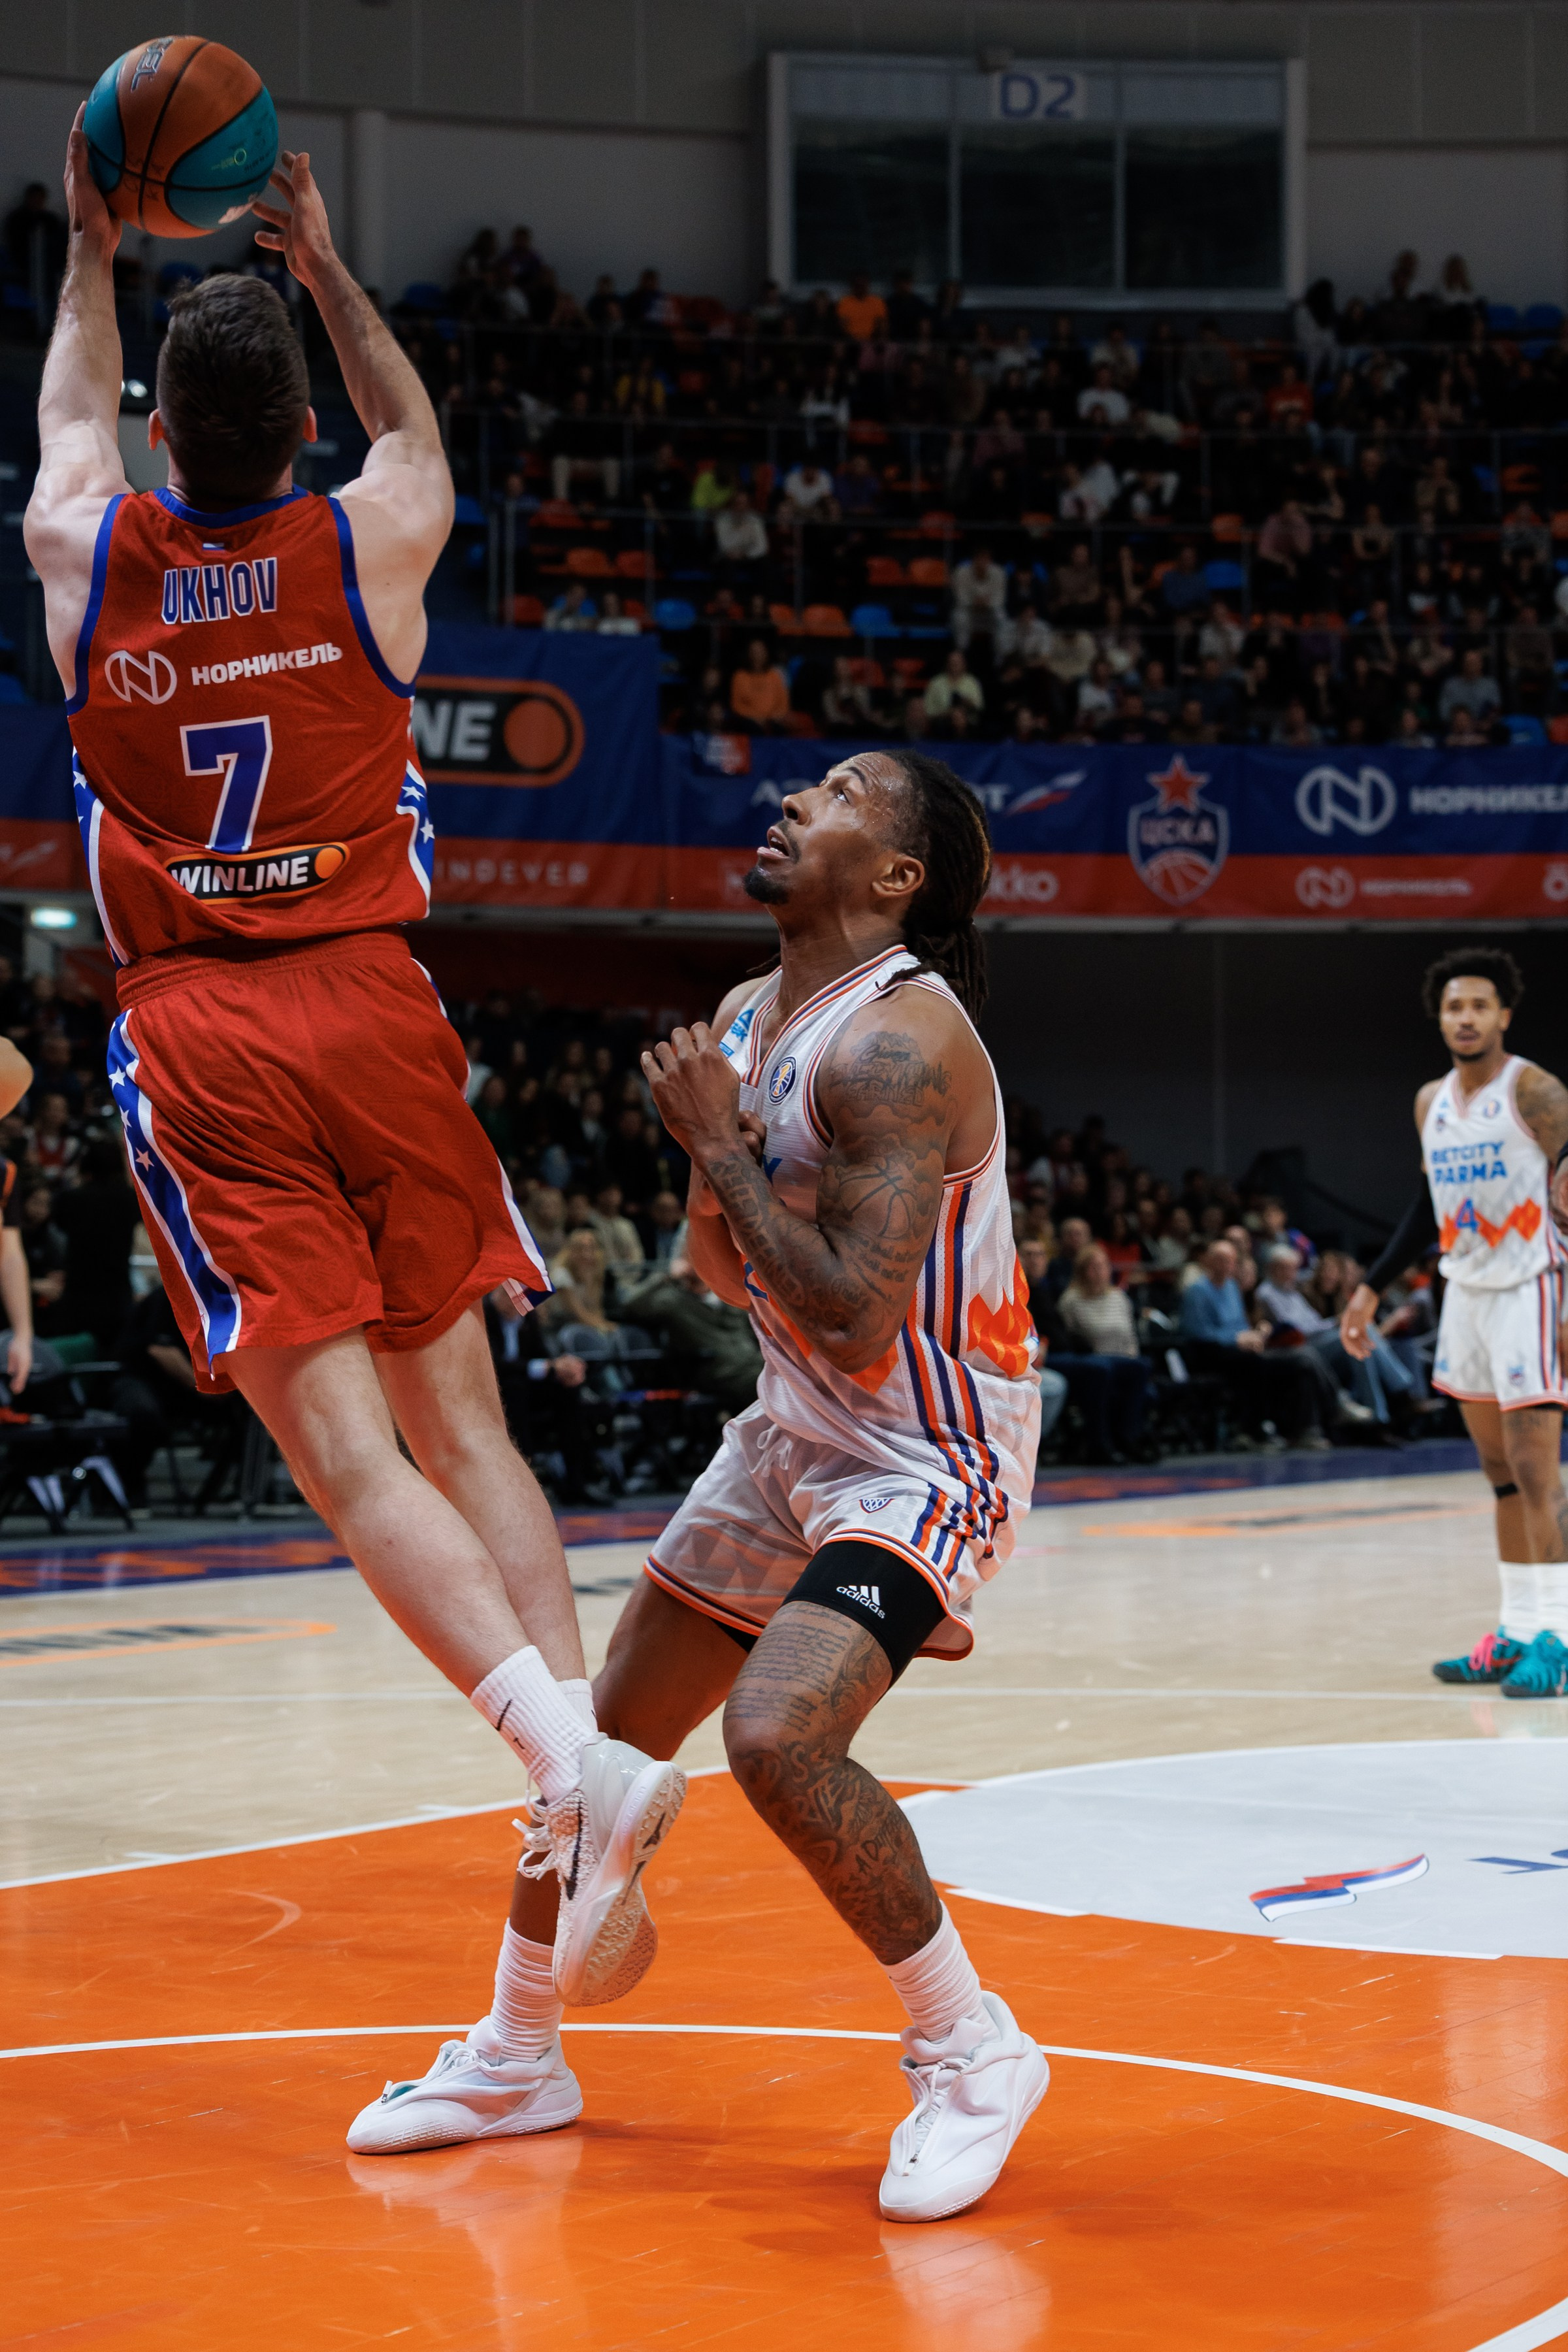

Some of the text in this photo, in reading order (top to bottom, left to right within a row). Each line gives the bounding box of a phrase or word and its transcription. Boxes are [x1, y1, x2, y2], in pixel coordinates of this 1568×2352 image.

[1000, 73, 1075, 118] D2
[161, 557, 277, 625] UKHOV
[191, 642, 342, 685] НОРНИКЕЛЬ
[180, 715, 273, 854] 7
[1409, 784, 1568, 816] НОРНИКЕ
[171, 855, 310, 894] WINLINE
[1431, 1142, 1504, 1164] BETCITY
[1435, 1161, 1507, 1184] PARMA
[1455, 1198, 1479, 1232] 4
[836, 1586, 885, 1619] adidas
